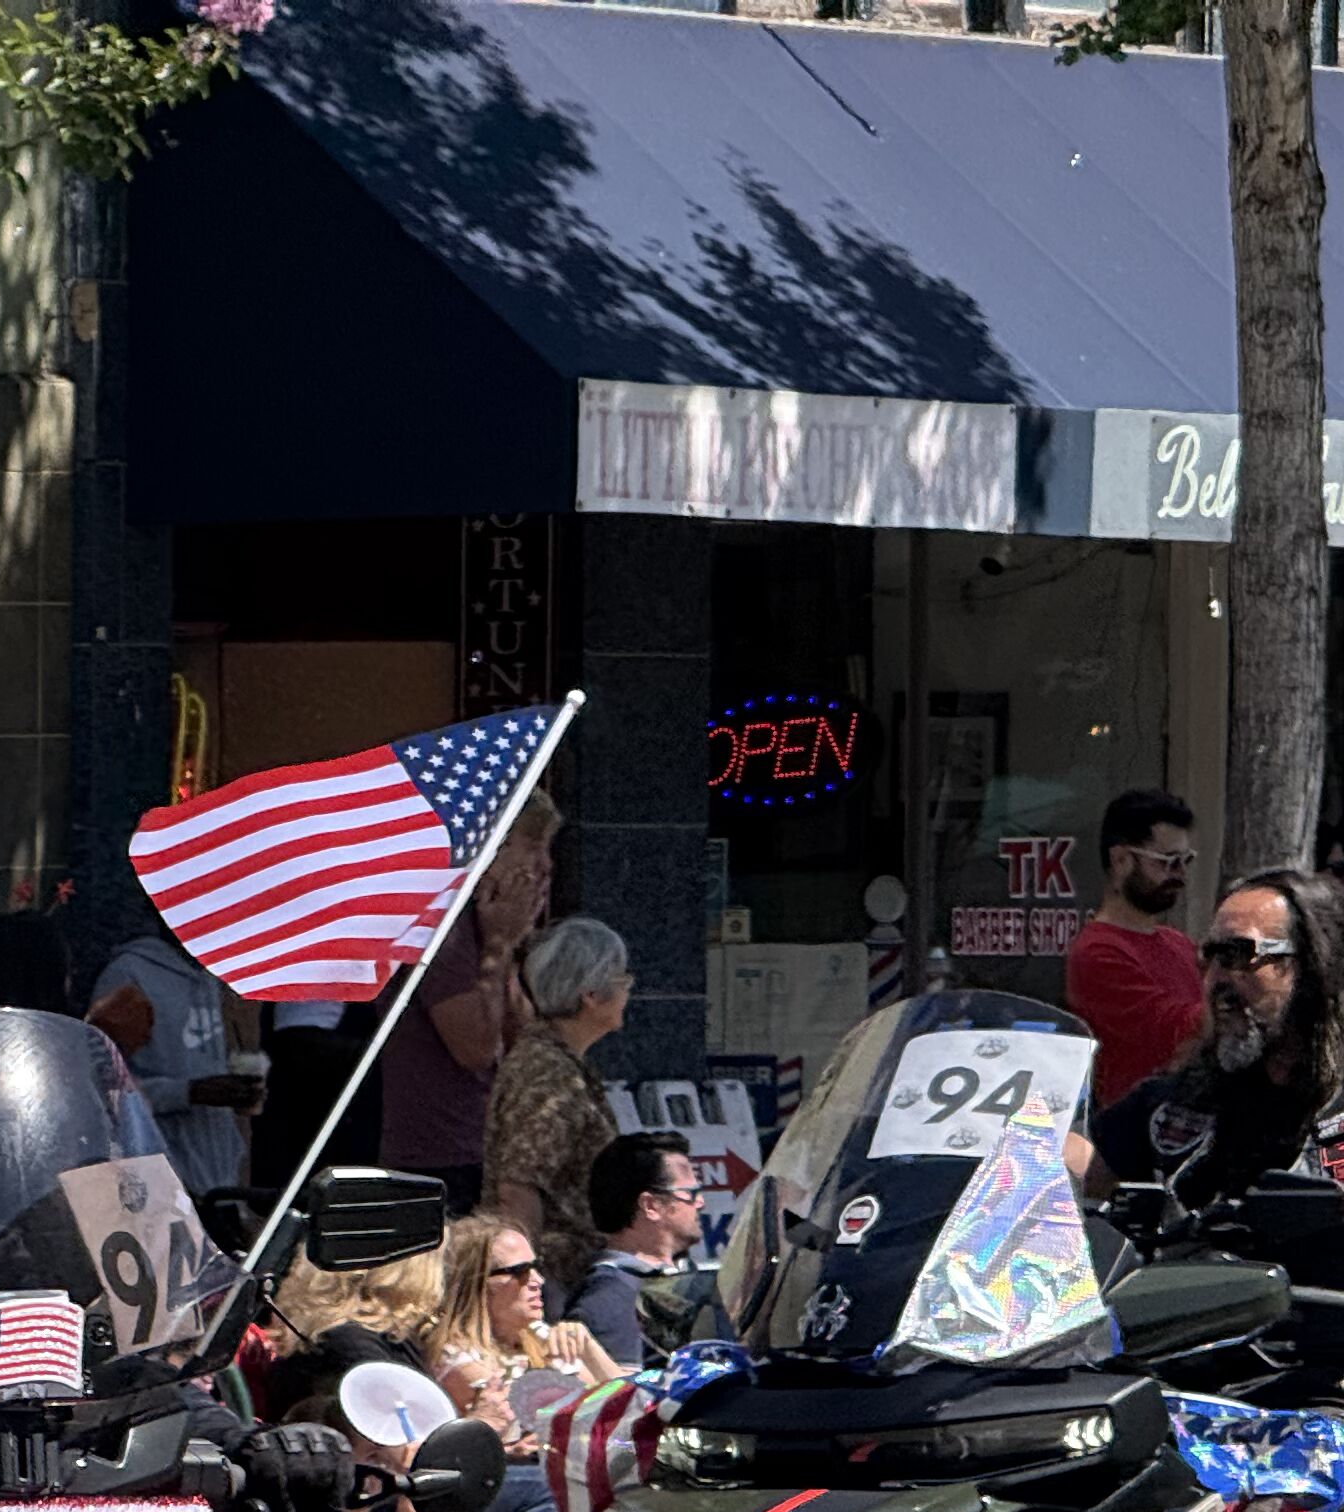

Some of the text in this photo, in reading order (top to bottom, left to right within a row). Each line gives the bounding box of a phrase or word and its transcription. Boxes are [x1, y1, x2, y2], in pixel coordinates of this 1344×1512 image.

[998, 836, 1076, 899] TK
[950, 907, 1080, 957] BARBER SHOP
[922, 1065, 1035, 1126] 94
[100, 1219, 202, 1347] 94
